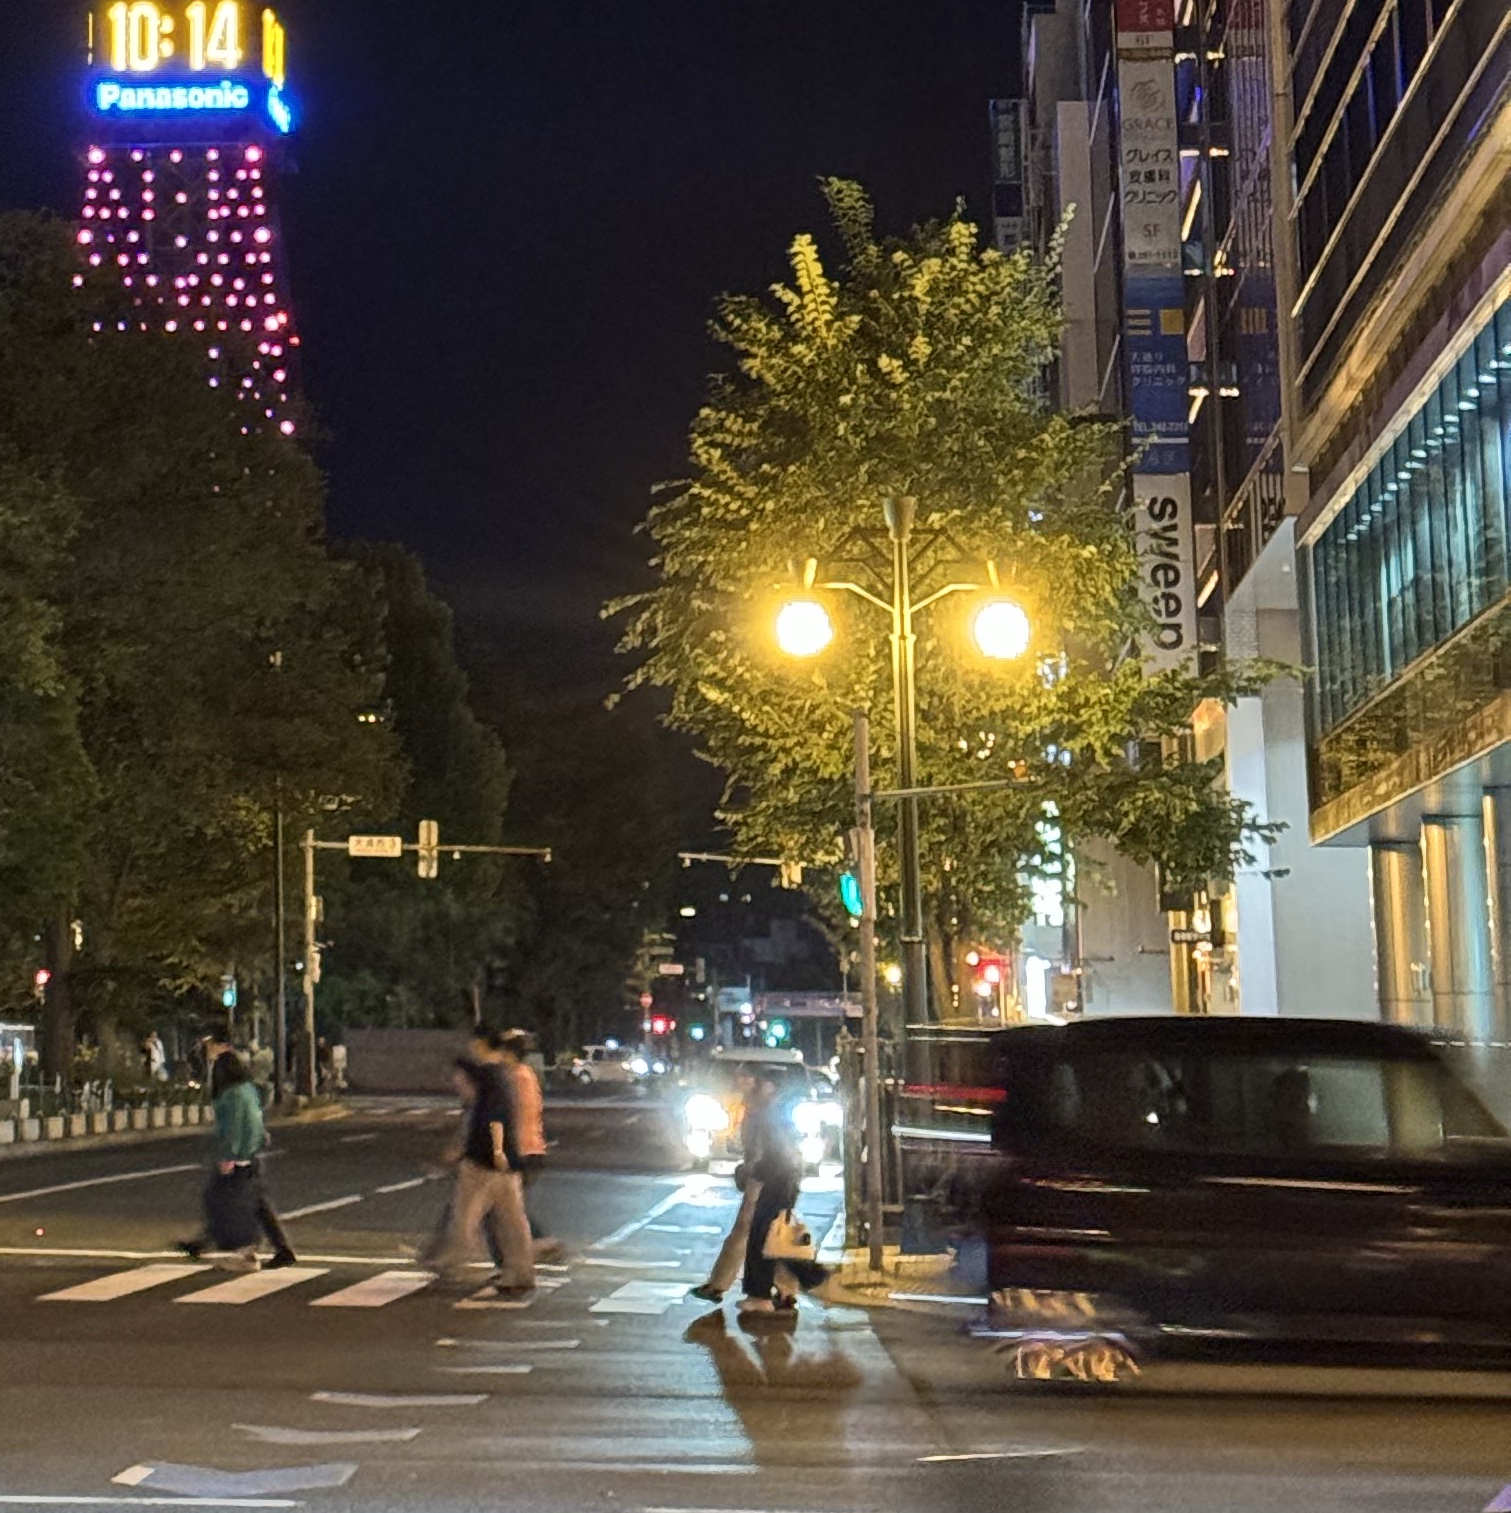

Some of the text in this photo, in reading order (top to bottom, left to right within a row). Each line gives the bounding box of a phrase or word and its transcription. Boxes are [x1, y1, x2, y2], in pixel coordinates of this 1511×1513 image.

[107, 0, 243, 72] 10:14
[96, 80, 249, 111] Panasonic
[1123, 189, 1179, 204] クリニック
